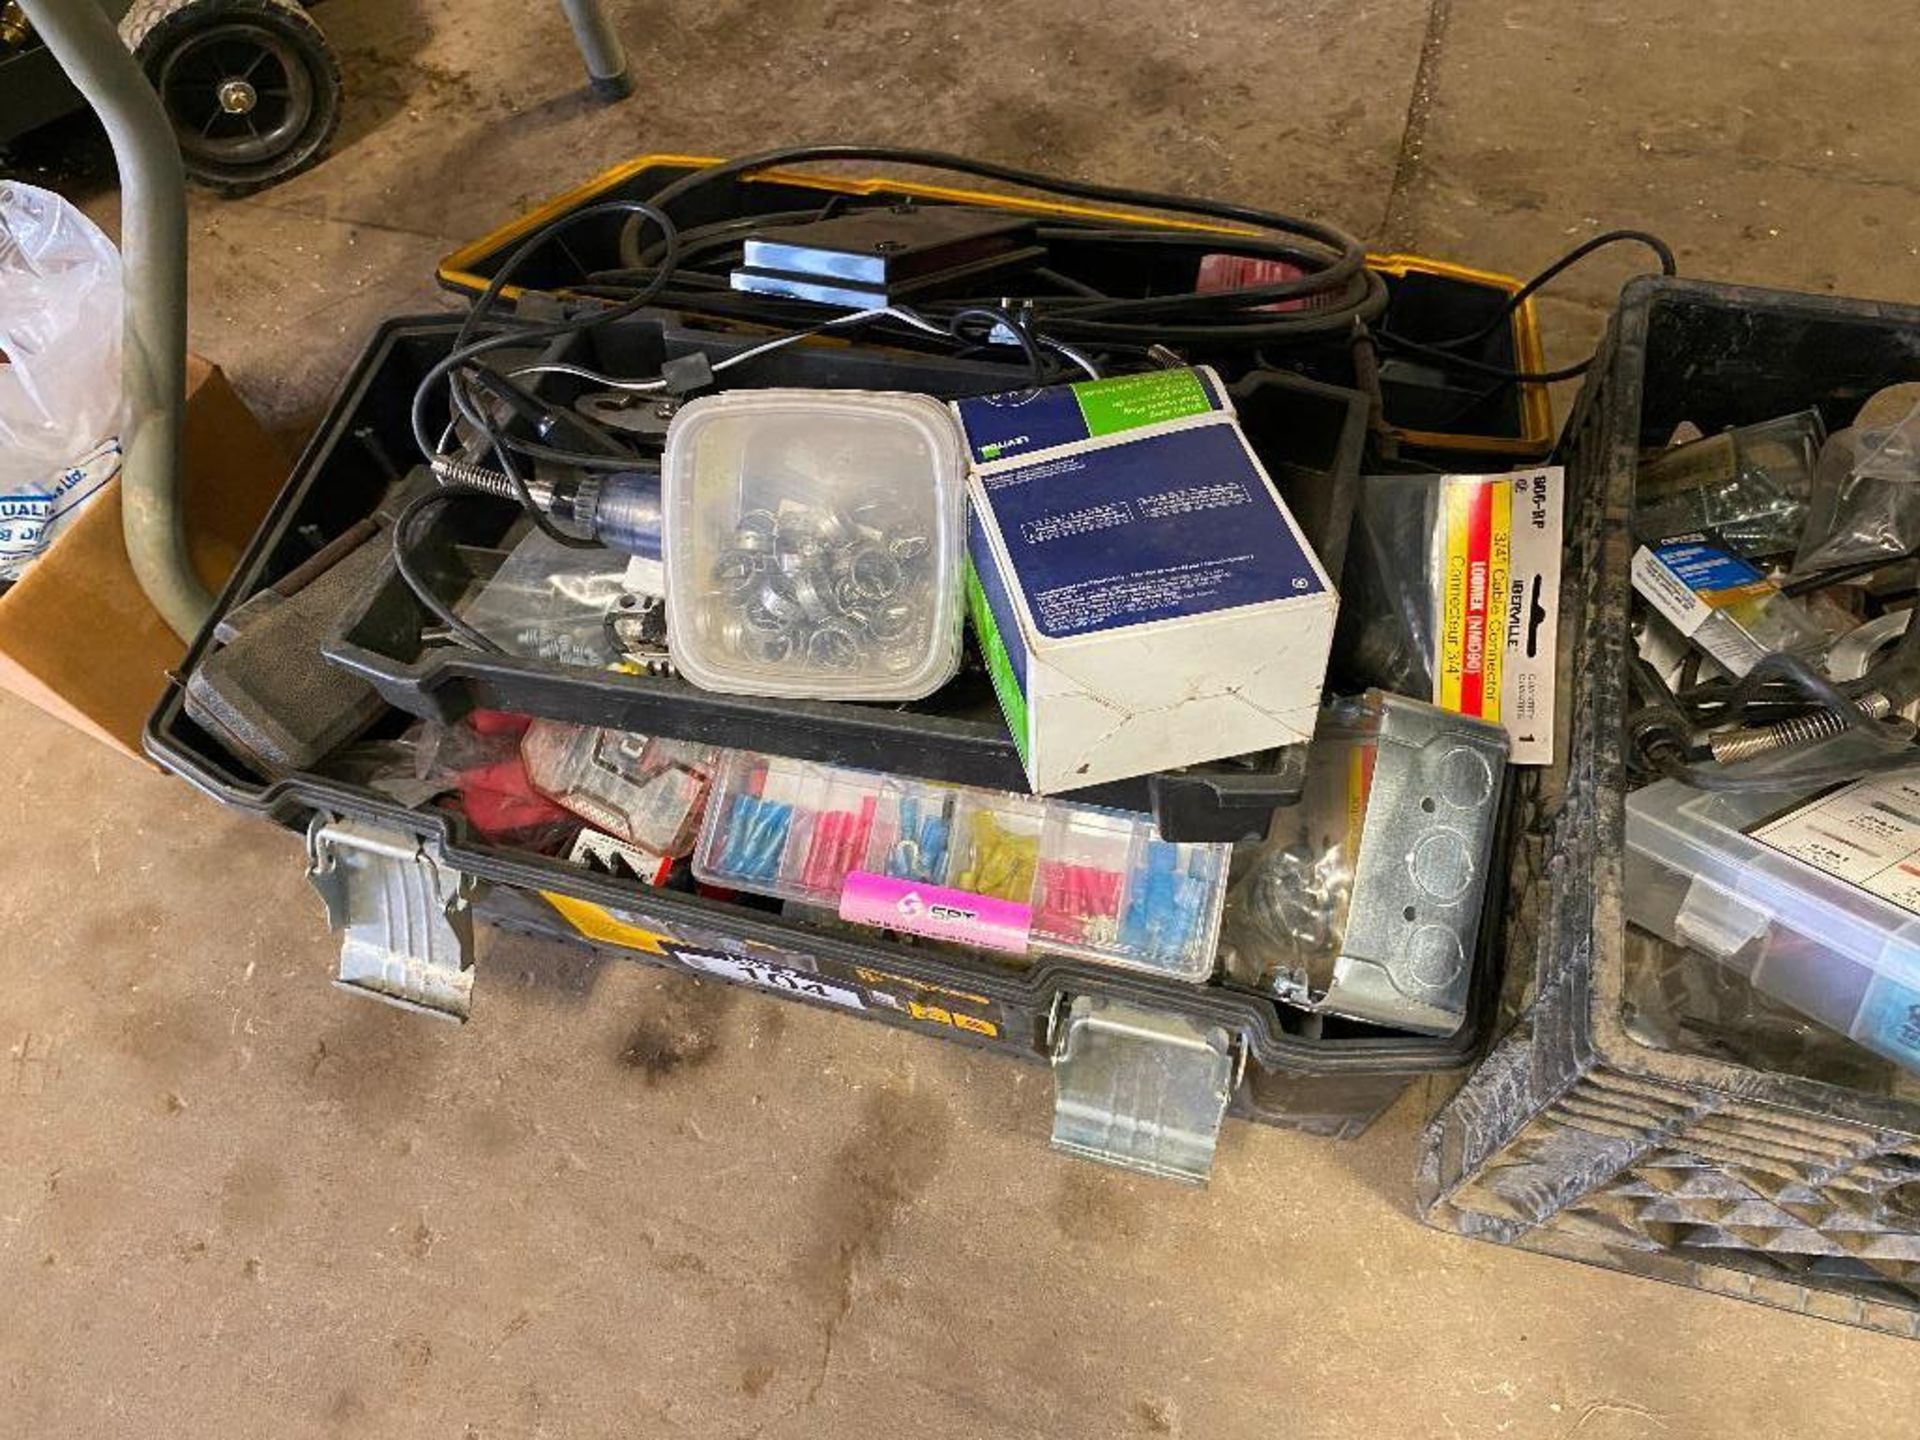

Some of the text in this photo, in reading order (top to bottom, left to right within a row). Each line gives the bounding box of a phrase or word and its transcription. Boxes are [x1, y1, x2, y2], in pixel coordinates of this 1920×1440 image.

[60, 469, 87, 490] Ltd.
[1447, 555, 1465, 645] Connecteur
[1490, 569, 1504, 615] Cable
[1508, 580, 1524, 648] IBERVILLE
[1486, 620, 1502, 701] Connector
[1518, 733, 1535, 744] 1
